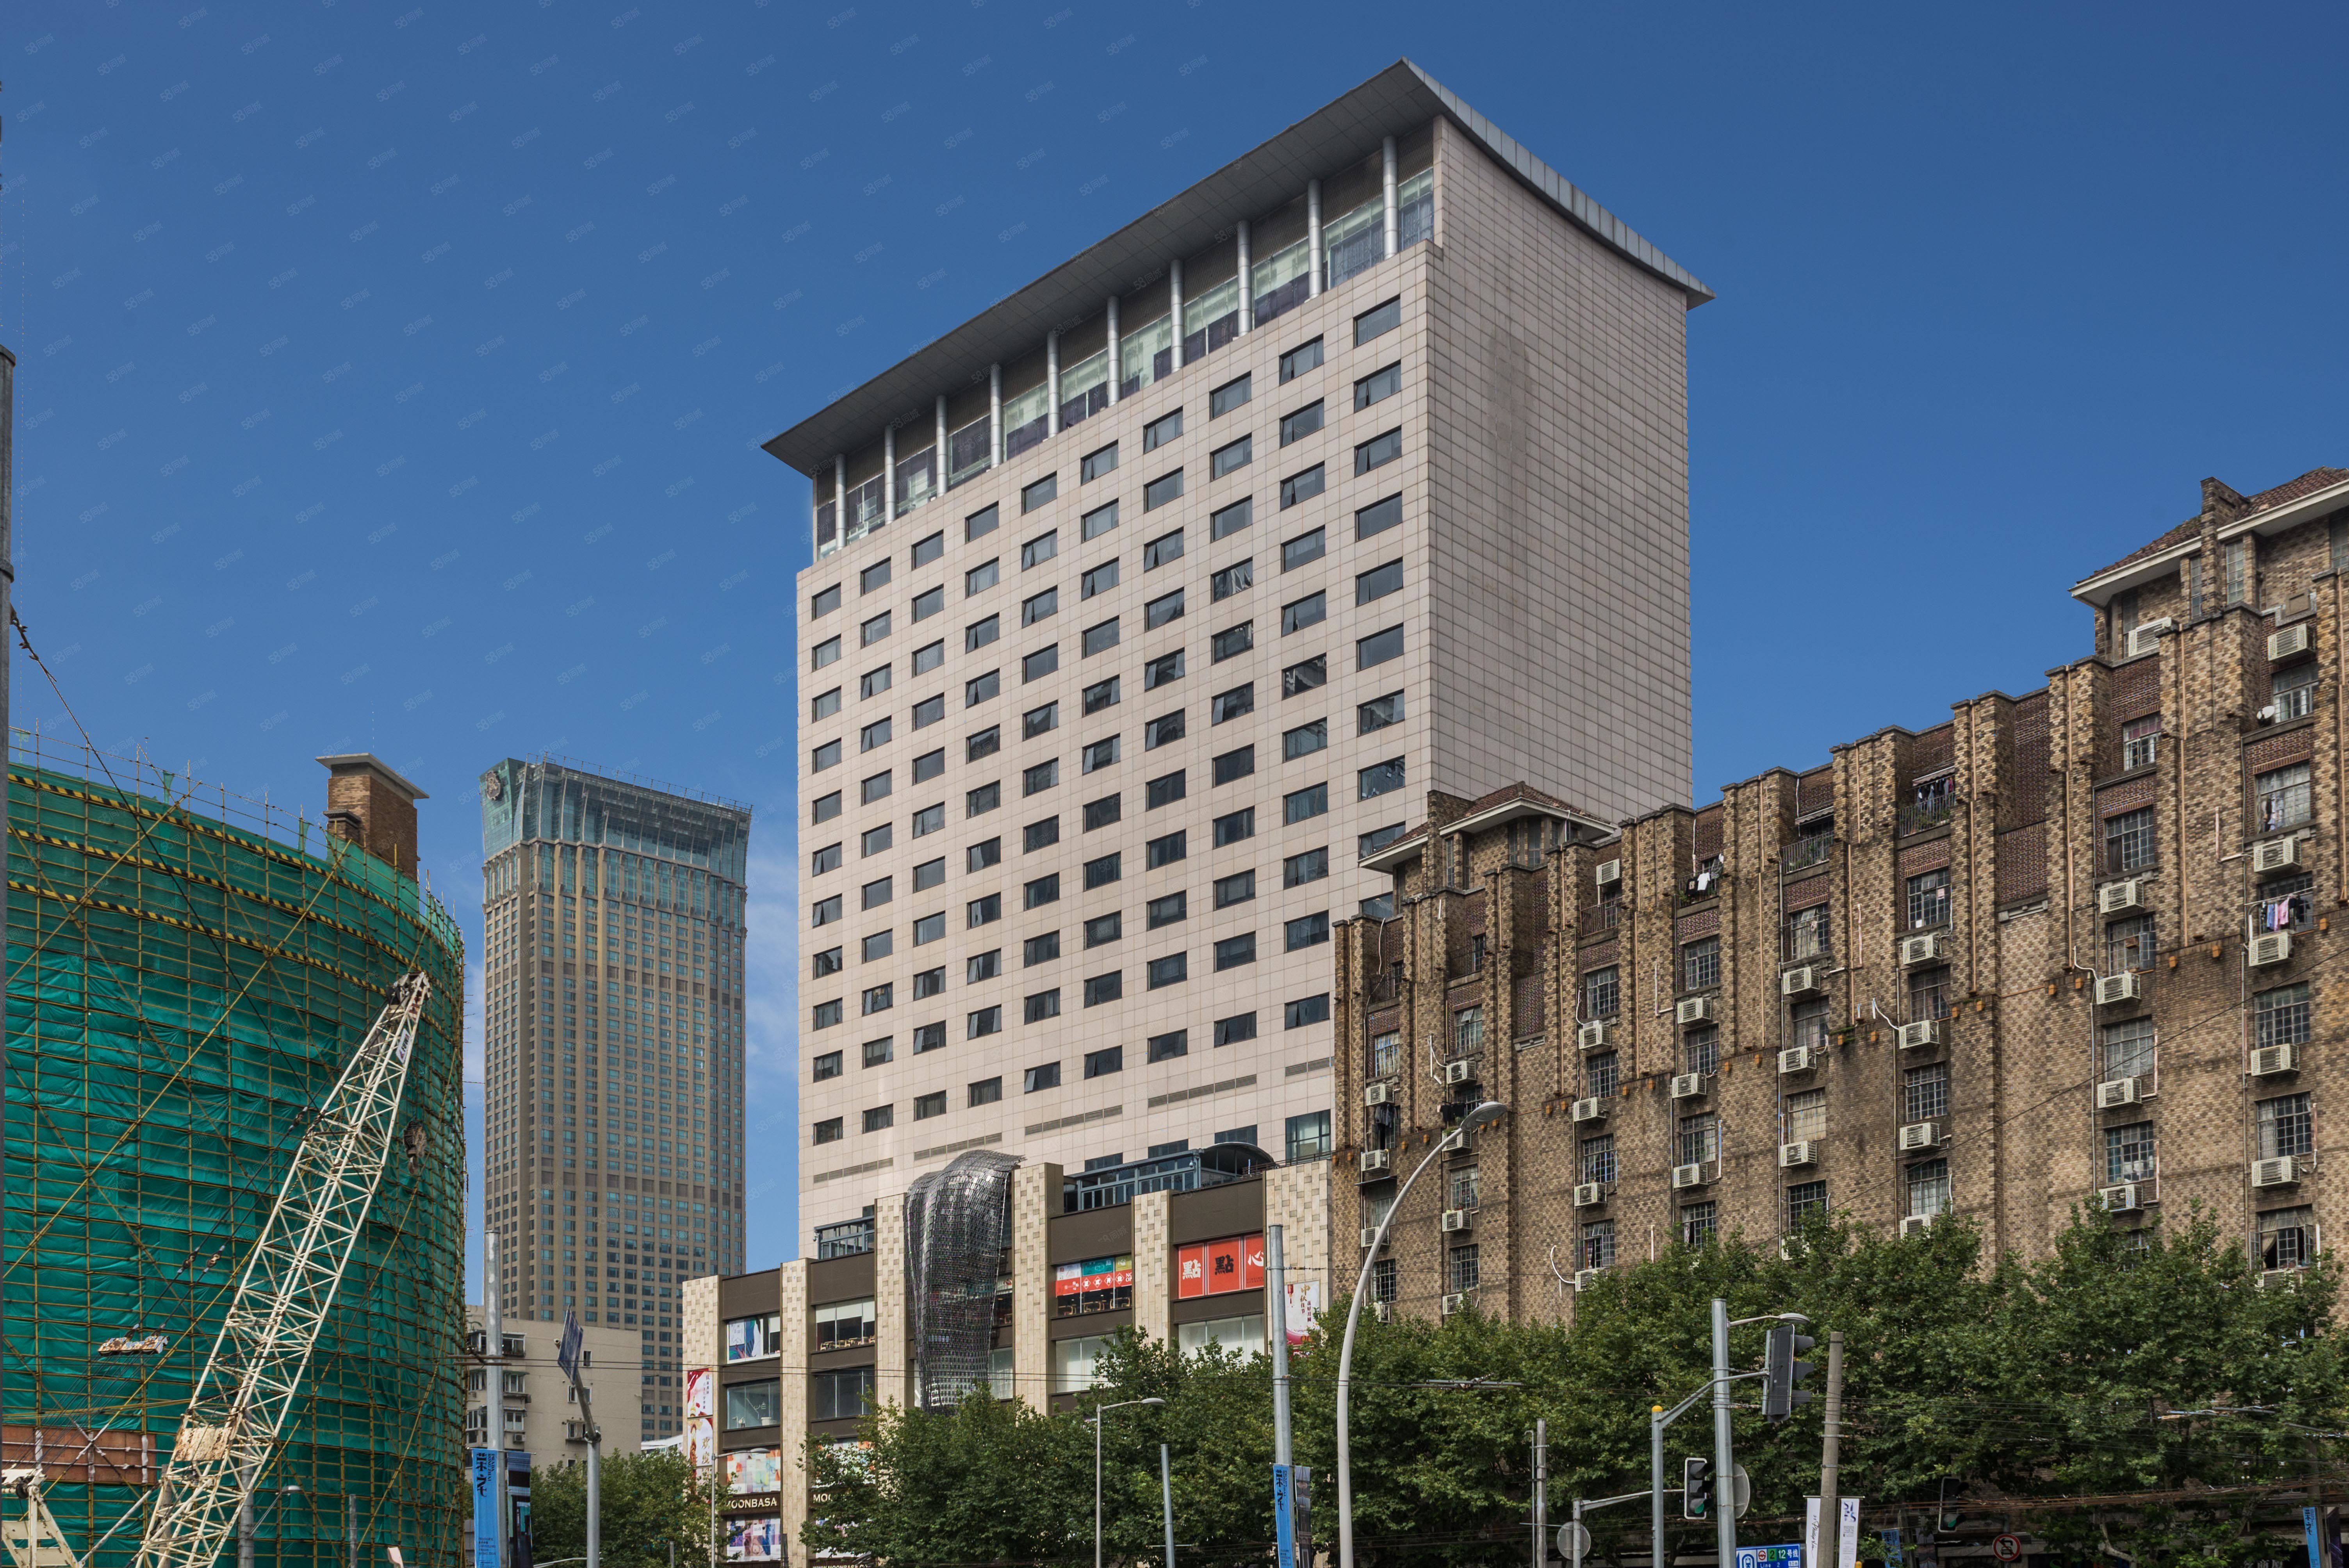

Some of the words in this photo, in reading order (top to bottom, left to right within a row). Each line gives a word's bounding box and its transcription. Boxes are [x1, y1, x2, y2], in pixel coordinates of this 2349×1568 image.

[1770, 1550, 1775, 1559] 2
[1778, 1549, 1786, 1559] 12
[1787, 1549, 1798, 1558] 号线
